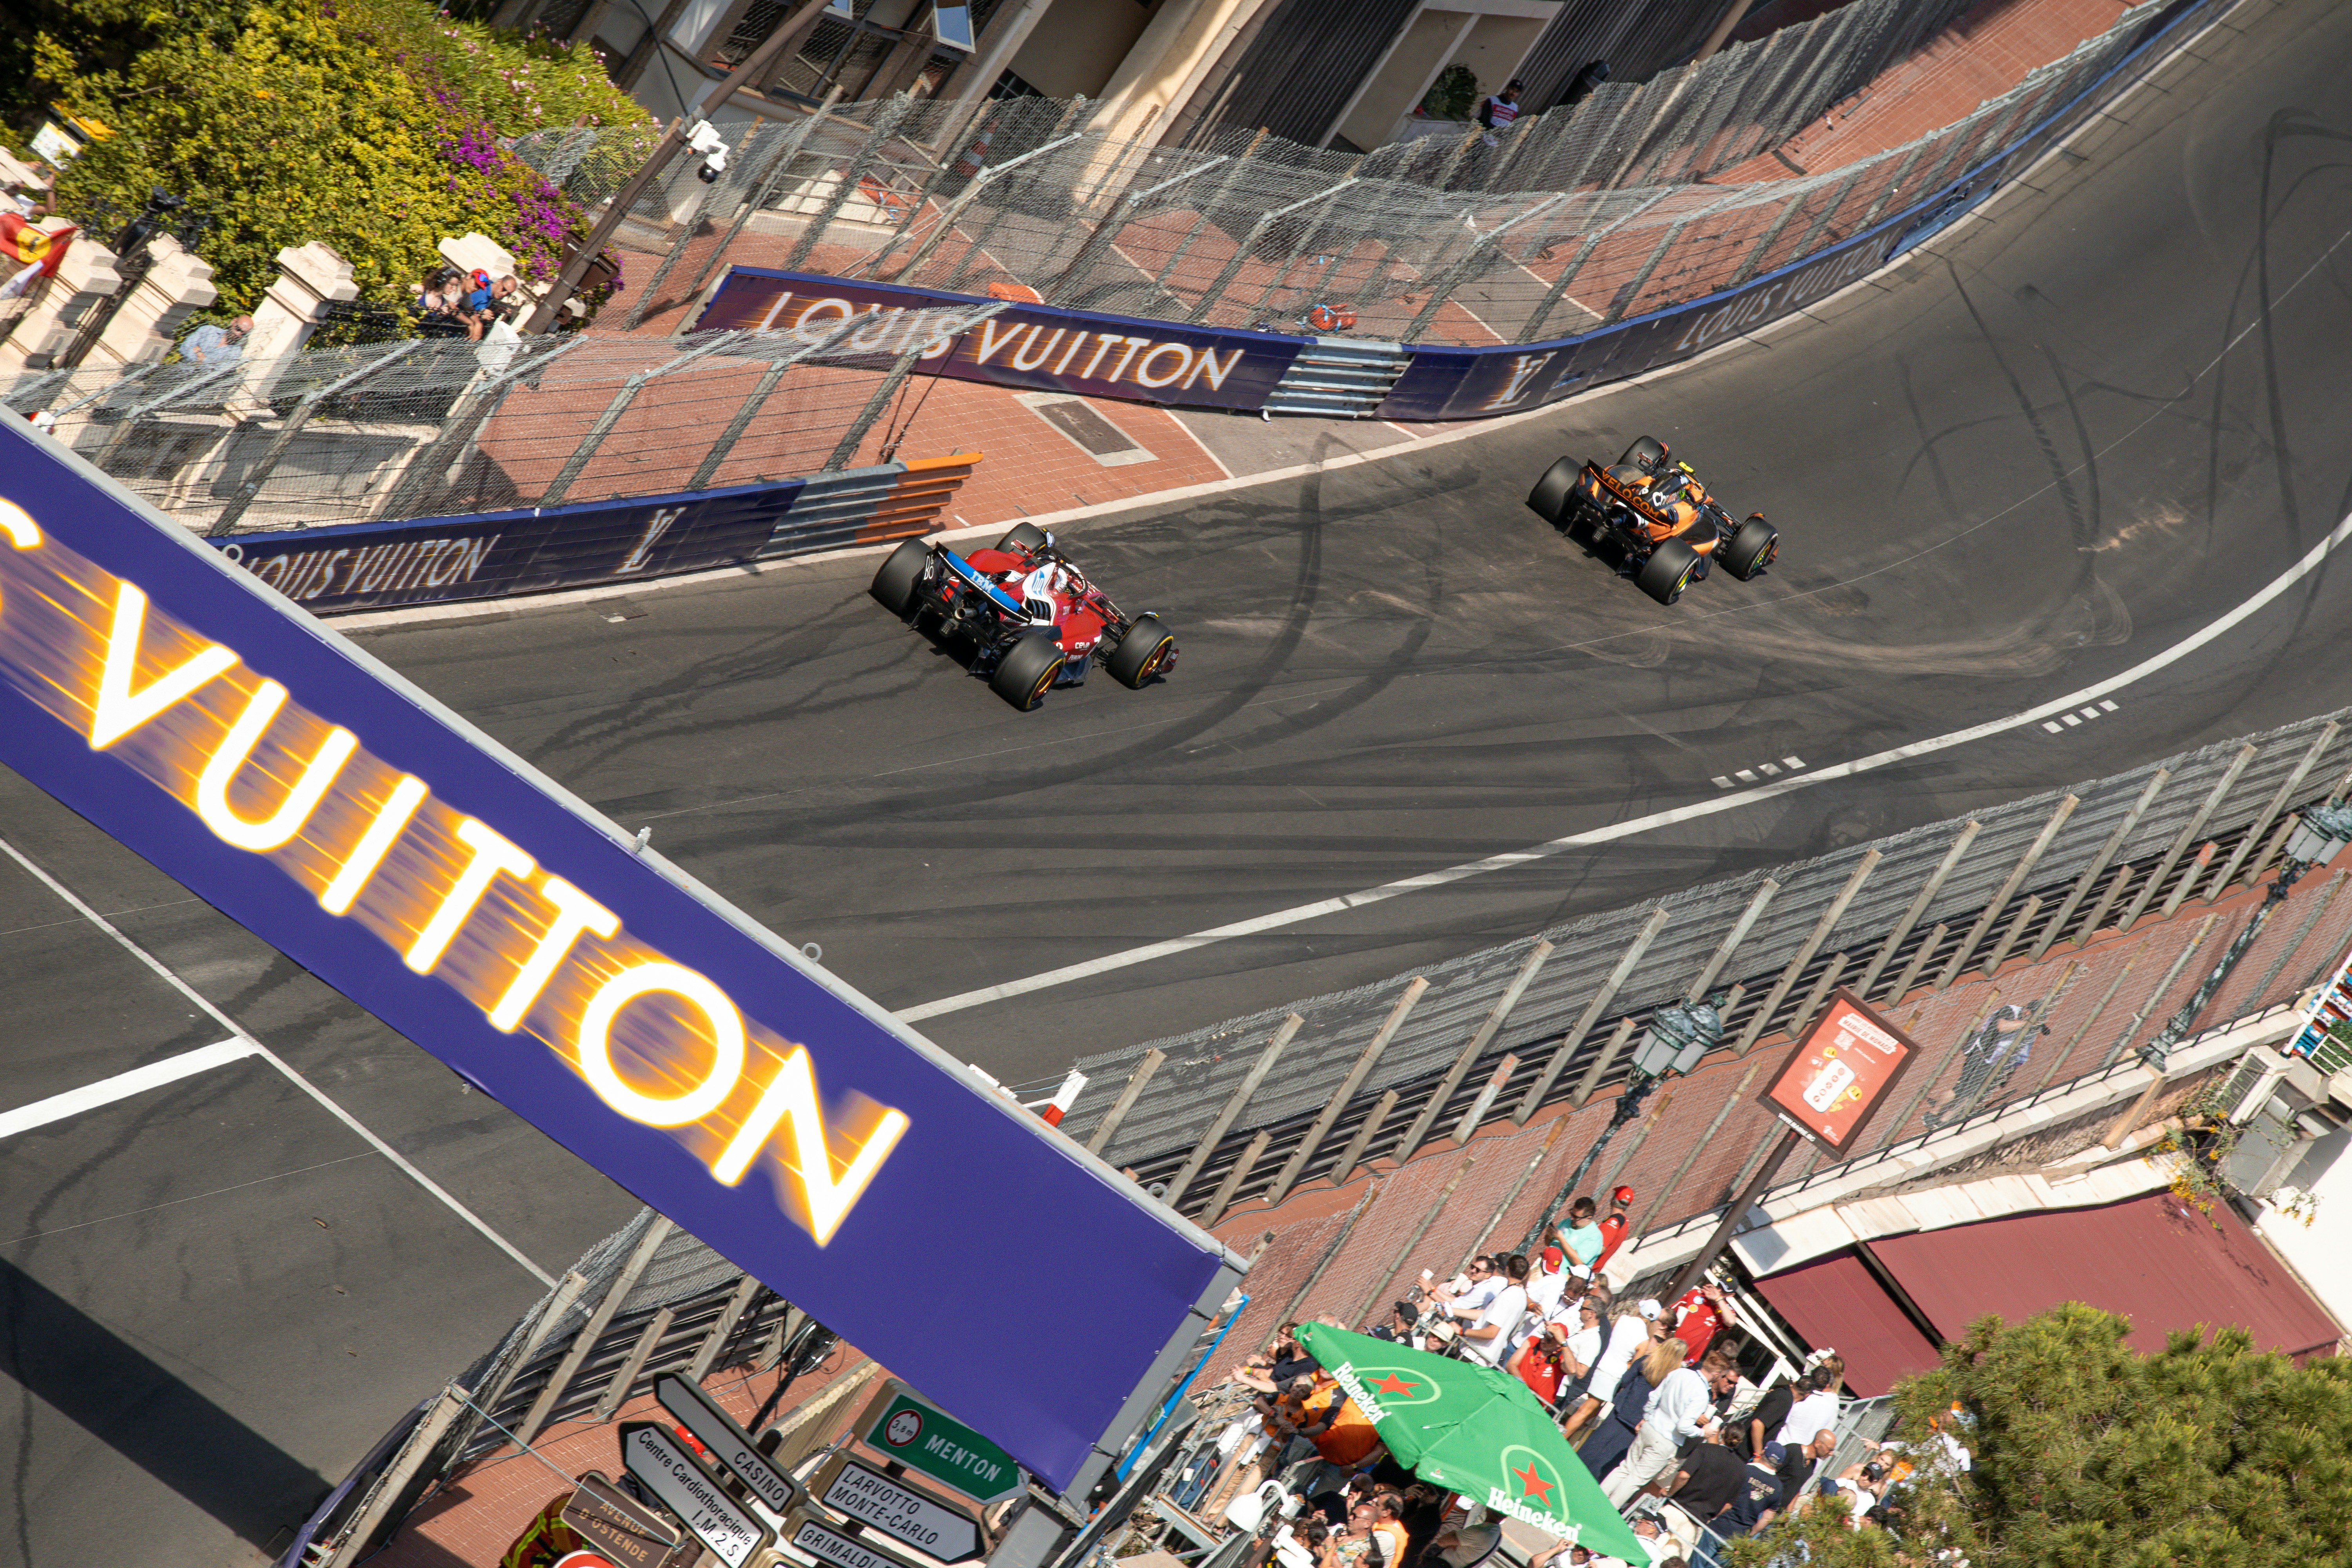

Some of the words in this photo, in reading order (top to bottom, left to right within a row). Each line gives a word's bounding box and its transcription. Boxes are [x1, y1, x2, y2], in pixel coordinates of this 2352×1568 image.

[1675, 283, 1782, 350] LOUIS
[1779, 227, 1902, 308] VUITTON
[754, 292, 966, 360] LOUIS
[977, 317, 1244, 392] VUITTON
[1601, 470, 1661, 518] VELO.COM
[340, 532, 502, 594] VUITTON
[969, 571, 995, 594] IBM
[1032, 570, 1045, 596] hp
[89, 579, 912, 1247] VUITTON
[1843, 1019, 1862, 1033] MAIRIE
[1869, 1035, 1892, 1051] MONACO
[1331, 1361, 1392, 1425] Heineken
[734, 1452, 785, 1501] CASINO
[924, 1434, 1002, 1482] MENTON
[638, 1431, 673, 1468] Centre
[671, 1463, 752, 1545] Cardiothoracique
[842, 1470, 920, 1515] LARVOTTO
[578, 1508, 649, 1562] D'OSTENDE
[599, 1501, 648, 1537] AVENUE
[831, 1486, 938, 1545] MONTE-CARLO
[1486, 1486, 1582, 1544] Heineken
[802, 1529, 878, 1568] GRIMALDI
